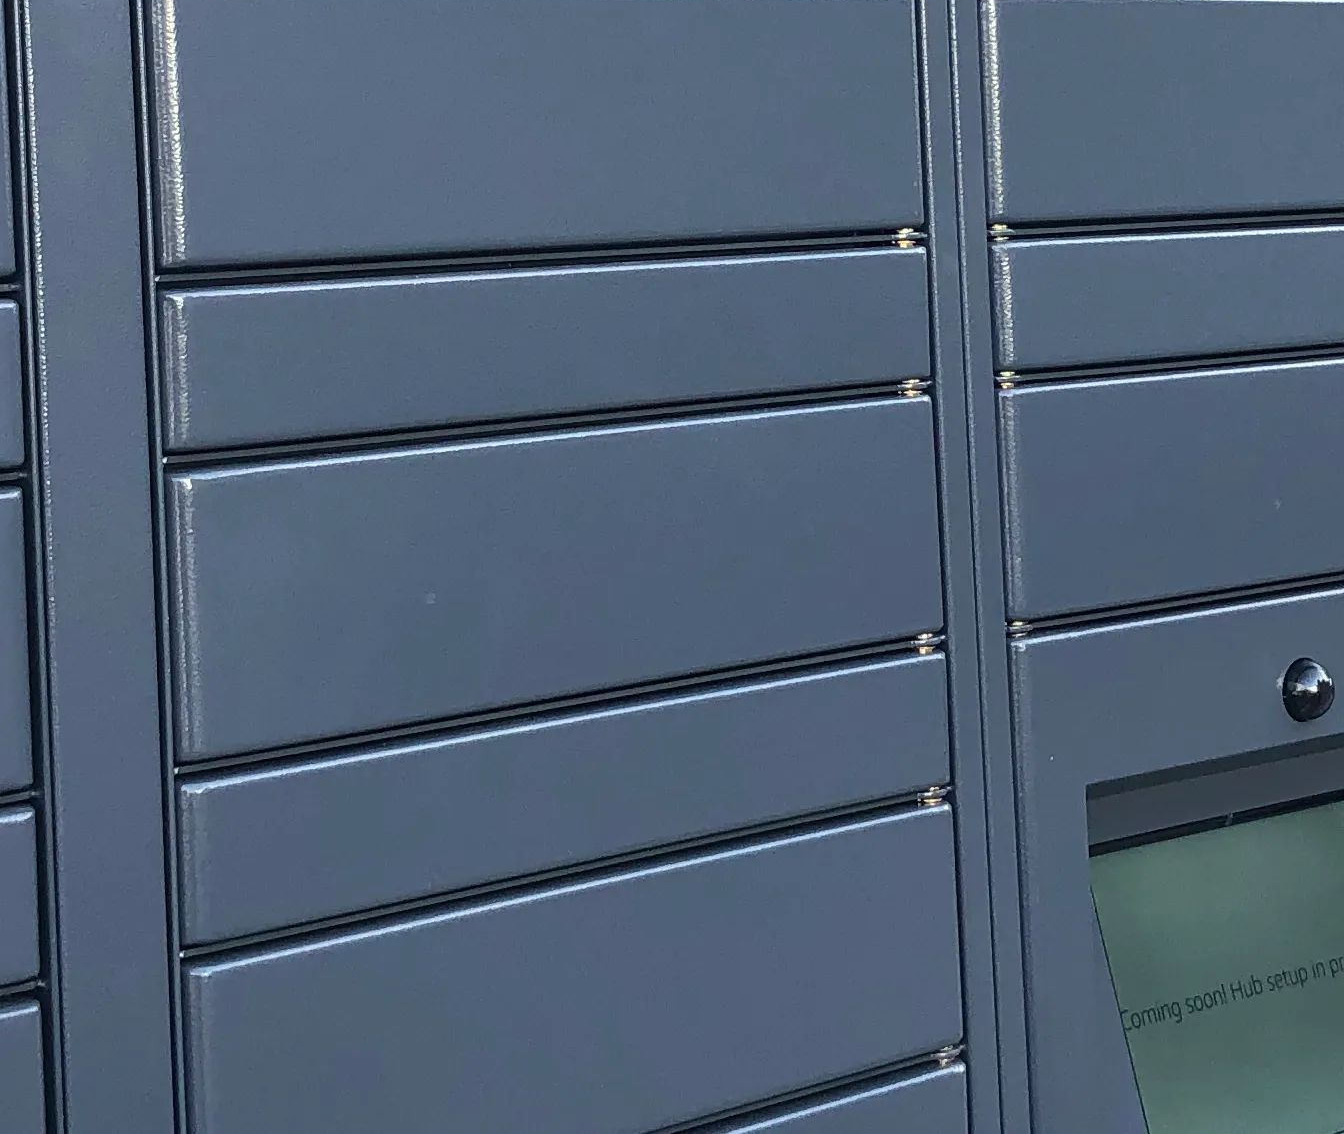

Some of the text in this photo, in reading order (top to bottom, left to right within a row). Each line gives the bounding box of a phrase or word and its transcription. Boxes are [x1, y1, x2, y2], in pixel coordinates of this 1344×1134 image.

[1185, 983, 1228, 1014] soon!
[1230, 975, 1263, 1001] Hub
[1266, 967, 1308, 991] setup
[1312, 960, 1326, 979] in
